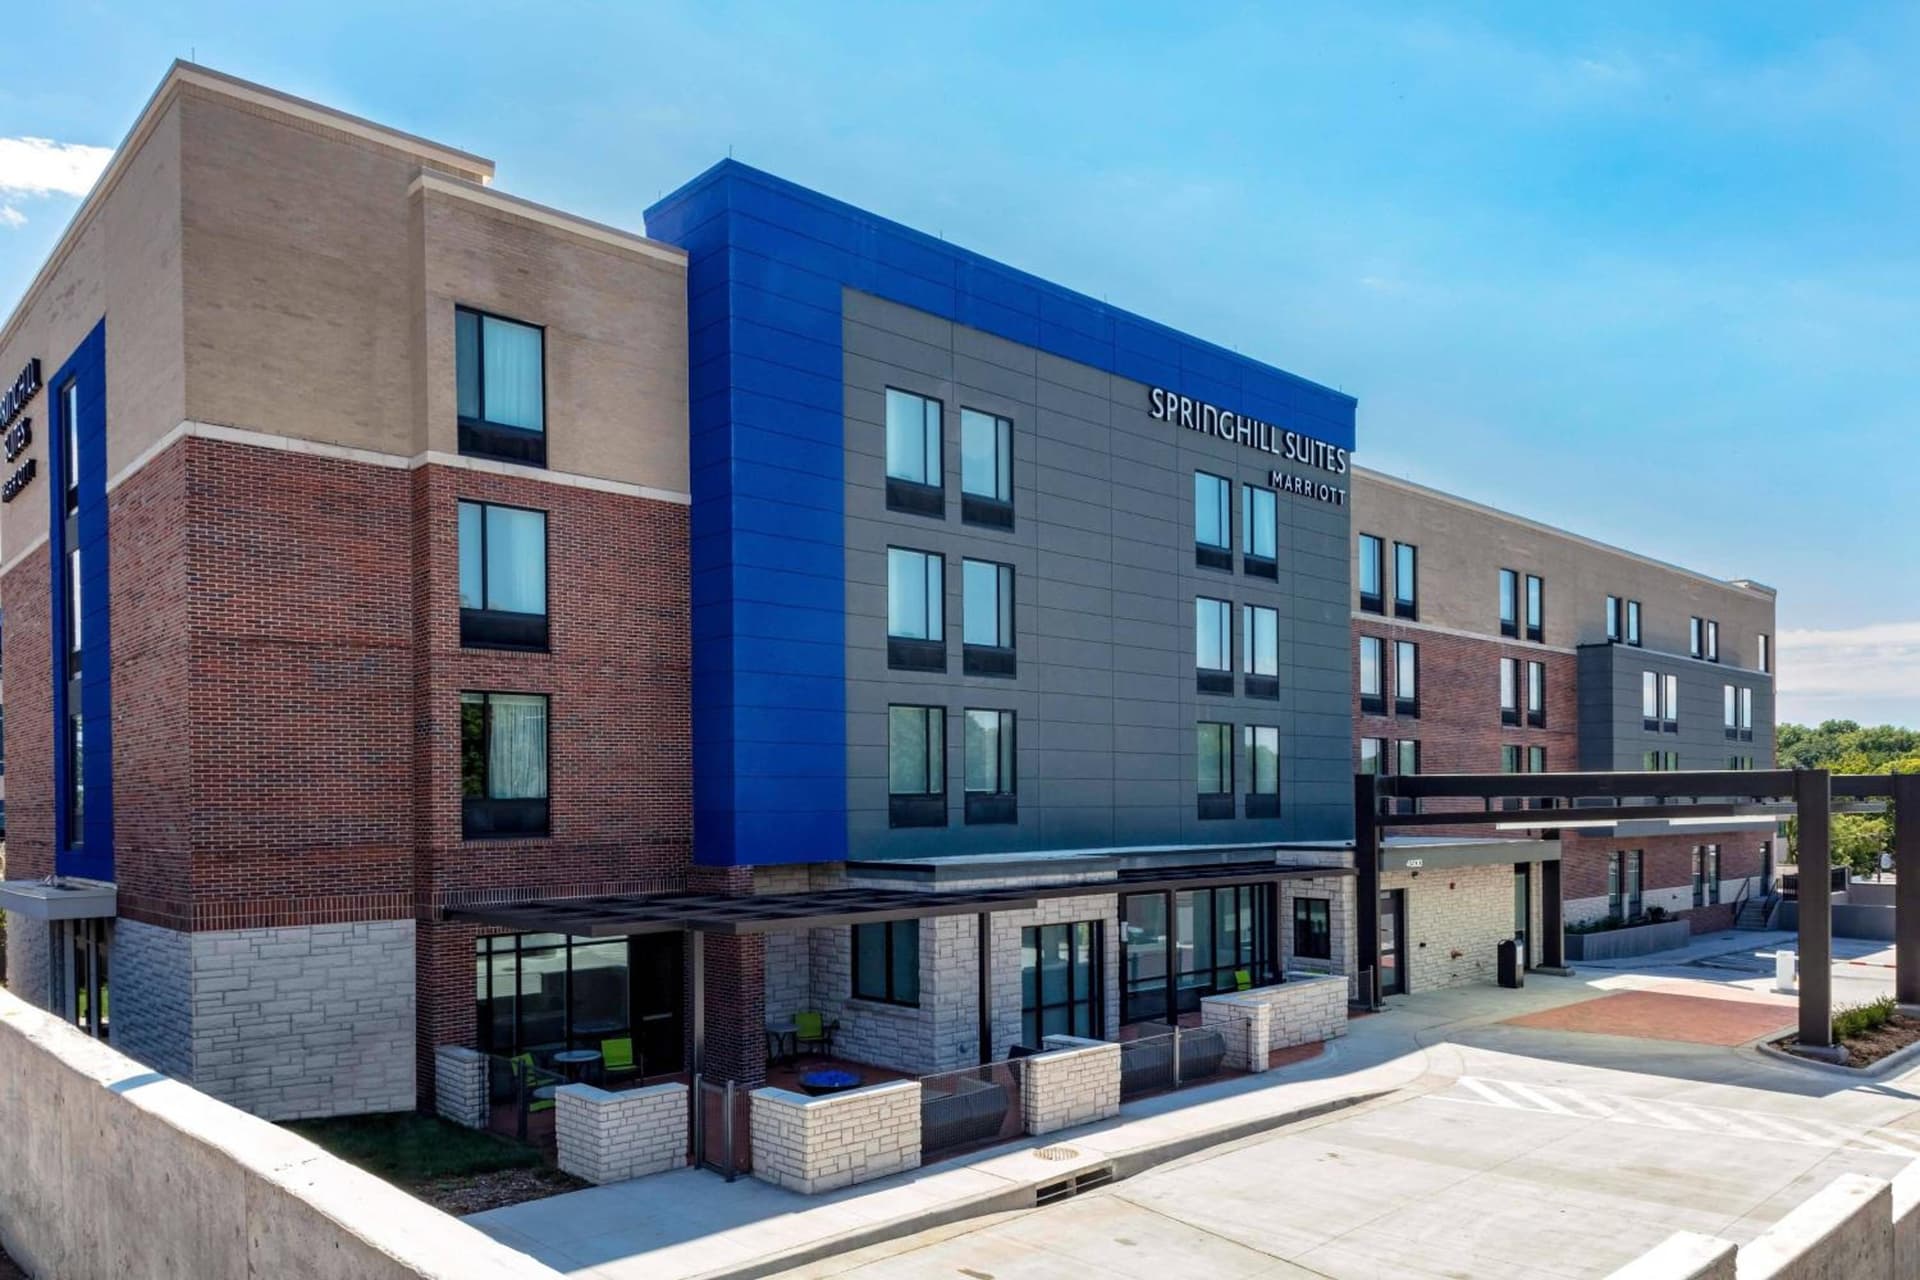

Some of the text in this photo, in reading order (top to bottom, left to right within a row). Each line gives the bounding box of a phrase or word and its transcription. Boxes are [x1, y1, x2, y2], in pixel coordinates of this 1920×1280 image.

[1151, 388, 1347, 474] SPRINGHILL SUITES
[1272, 469, 1347, 506] MARRIOTT
